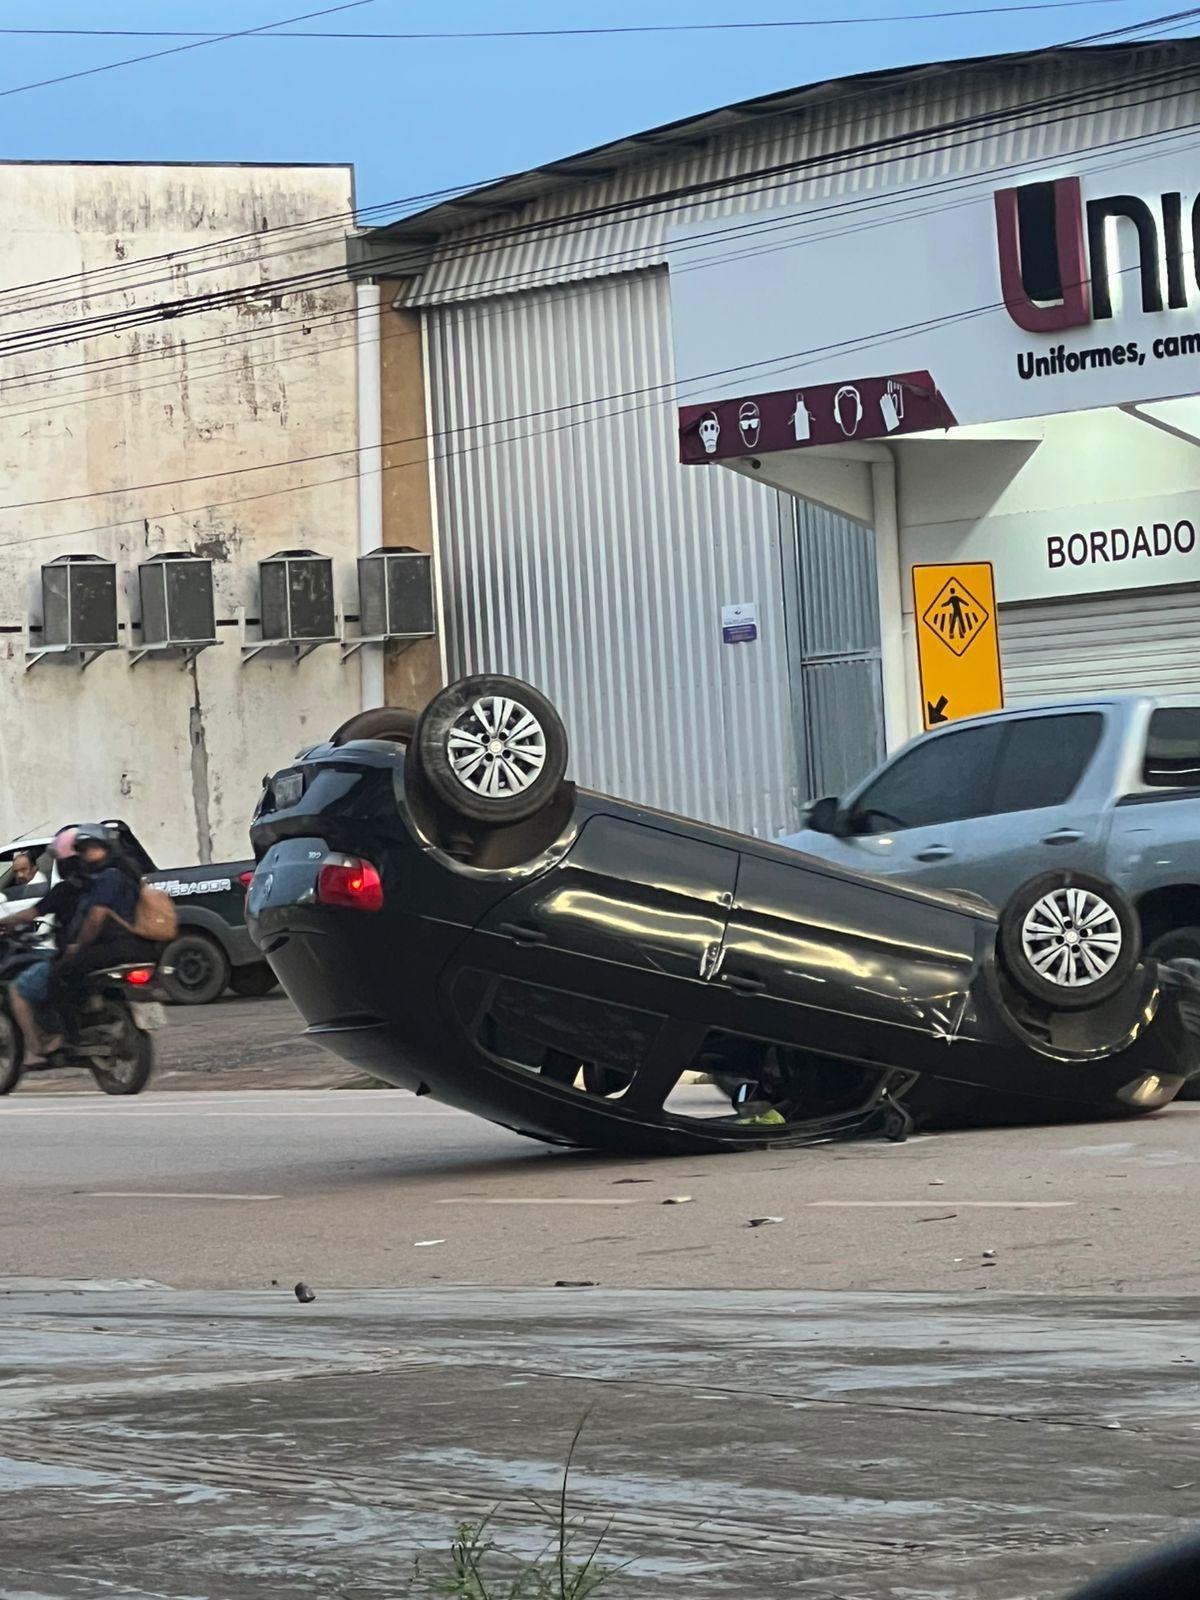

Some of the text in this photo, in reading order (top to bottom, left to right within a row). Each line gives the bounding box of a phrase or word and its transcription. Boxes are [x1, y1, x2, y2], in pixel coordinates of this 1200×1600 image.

[994, 176, 1200, 333] Uni
[1017, 342, 1146, 379] Uniformes,
[1047, 520, 1195, 568] BORDADO
